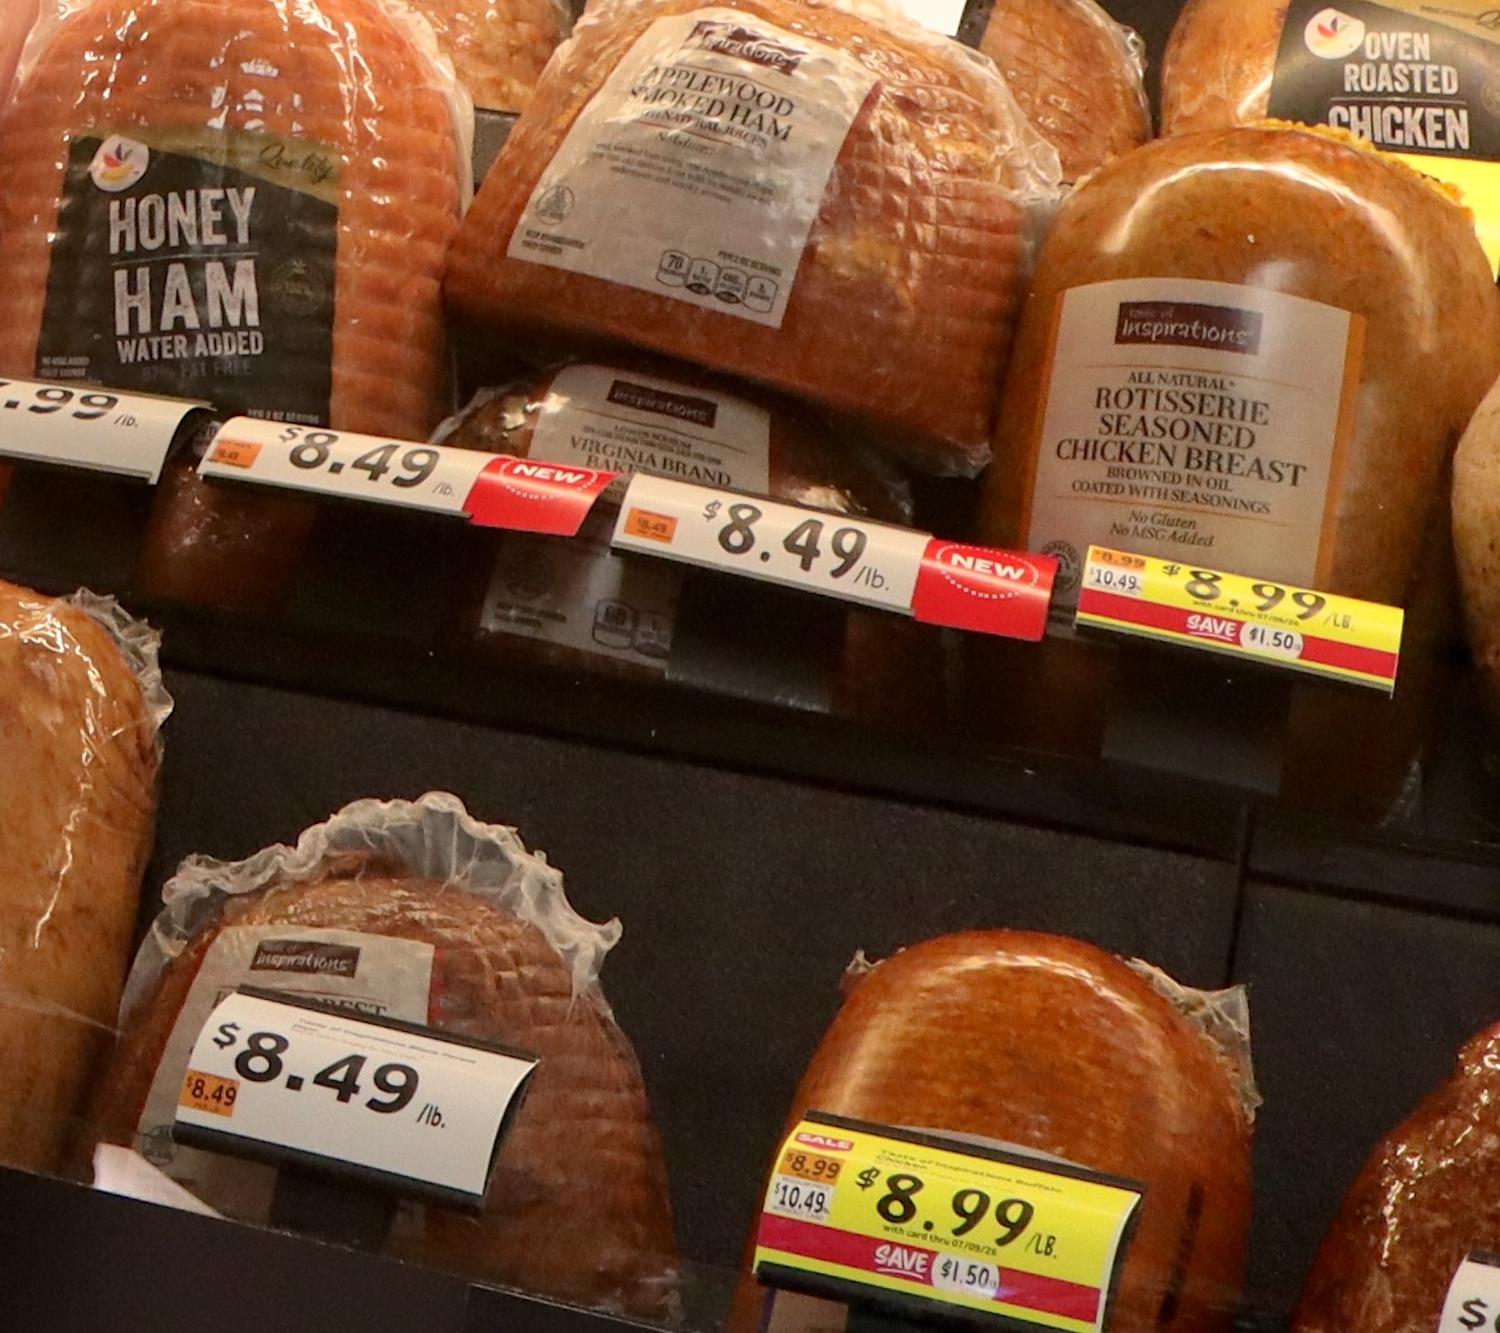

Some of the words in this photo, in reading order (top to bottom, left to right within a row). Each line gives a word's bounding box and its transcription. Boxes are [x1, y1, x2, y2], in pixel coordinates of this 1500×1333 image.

[1363, 31, 1431, 63] OVEN
[642, 65, 796, 119] APPLEWOOD
[1342, 63, 1460, 96] ROASTED
[629, 85, 725, 122] SMOKED
[730, 102, 795, 144] HAM
[1327, 101, 1471, 151] CHICKEN
[108, 186, 257, 255] HONEY
[113, 259, 261, 337] HAM
[116, 334, 189, 365] WATER
[194, 330, 265, 358] ADDED
[1121, 318, 1249, 346] Inspirations
[1127, 370, 1155, 384] ALL
[1094, 386, 1271, 426] ROTISSERIE
[1098, 412, 1256, 451] SEASONED
[277, 426, 441, 489] $8.49
[510, 462, 587, 485] NEW
[568, 434, 659, 471] VIRGINIA
[660, 455, 733, 489] BRAND
[1055, 438, 1178, 468] CHICKEN
[1183, 446, 1308, 488] BREAST
[1071, 479, 1127, 497] COATED
[1127, 484, 1169, 501] WITH
[1170, 488, 1272, 515] SEASONINGS
[1106, 466, 1183, 486] BROWNED
[1185, 474, 1203, 487] IN
[1205, 476, 1234, 493] OIL
[1109, 522, 1129, 537] No
[1131, 526, 1167, 542] MSG
[1168, 529, 1215, 548] Added
[1128, 510, 1149, 525] No
[1150, 512, 1198, 531] Gluten
[701, 499, 870, 579] $8.49
[852, 562, 891, 593] /lb.
[948, 550, 1027, 582] NEW
[1161, 562, 1327, 622] $8.99
[1185, 613, 1238, 639] SAVE
[1248, 626, 1295, 652] $1.50
[187, 1074, 238, 1108] $8.49
[211, 1021, 421, 1115] $8.49
[415, 1102, 447, 1130] /lb.
[785, 1150, 841, 1180] $8.99
[773, 1182, 826, 1214] $10.49
[855, 1166, 1036, 1248] $8.99
[1024, 1233, 1058, 1260] /LB.
[872, 1242, 929, 1275] SAVE
[939, 1259, 991, 1289] $1.50
